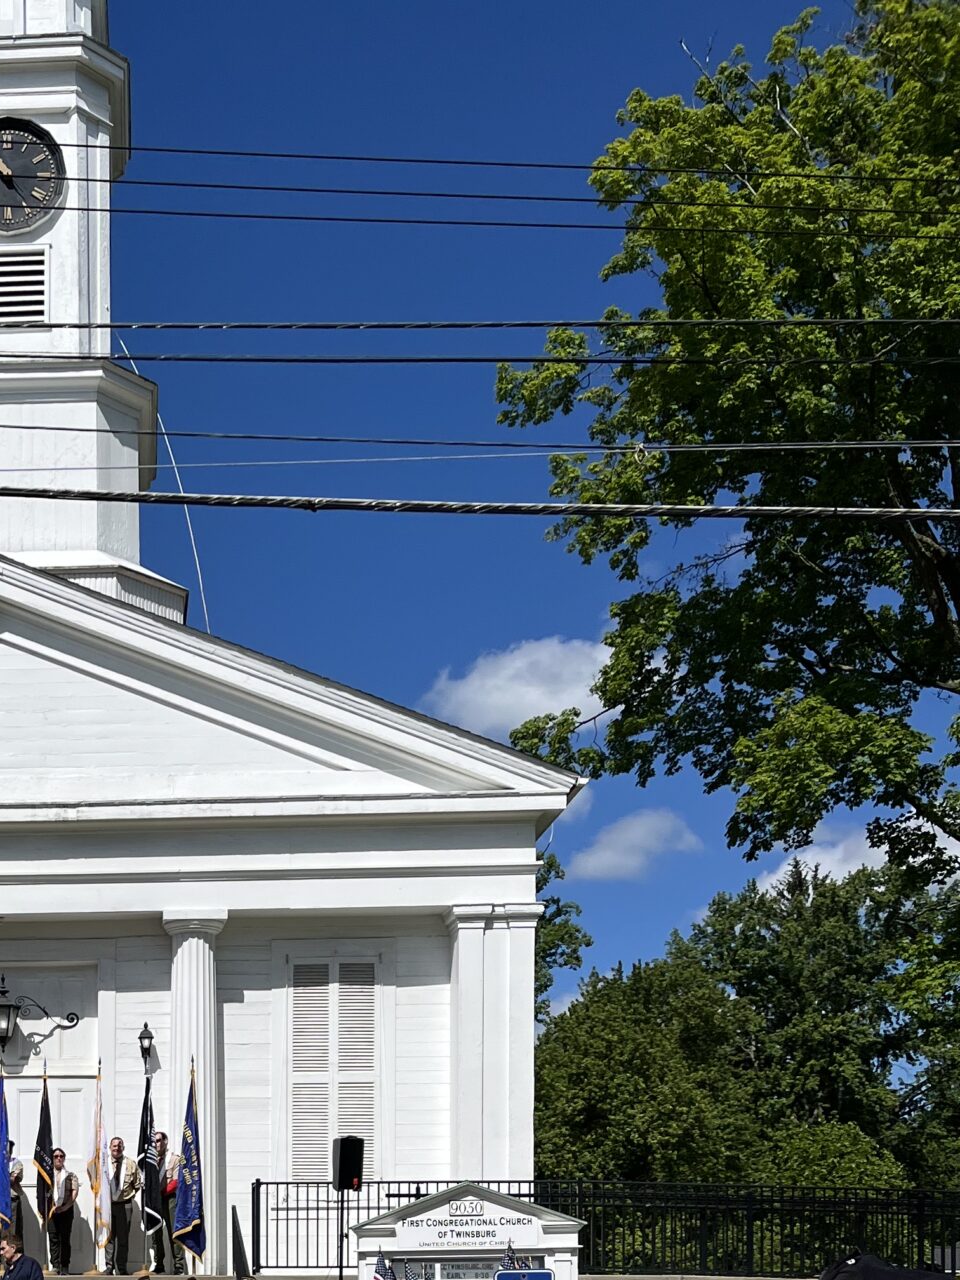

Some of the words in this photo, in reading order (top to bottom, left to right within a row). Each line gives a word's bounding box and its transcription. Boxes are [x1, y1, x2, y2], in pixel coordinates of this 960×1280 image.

[450, 1202, 483, 1215] 9050
[401, 1219, 424, 1228] FIRST
[426, 1218, 498, 1228] CONGREGATIONAL
[499, 1217, 533, 1226] CHURCH
[437, 1231, 448, 1239] OF
[449, 1230, 497, 1239] TWINSBURG
[446, 1272, 466, 1280] EARLY
